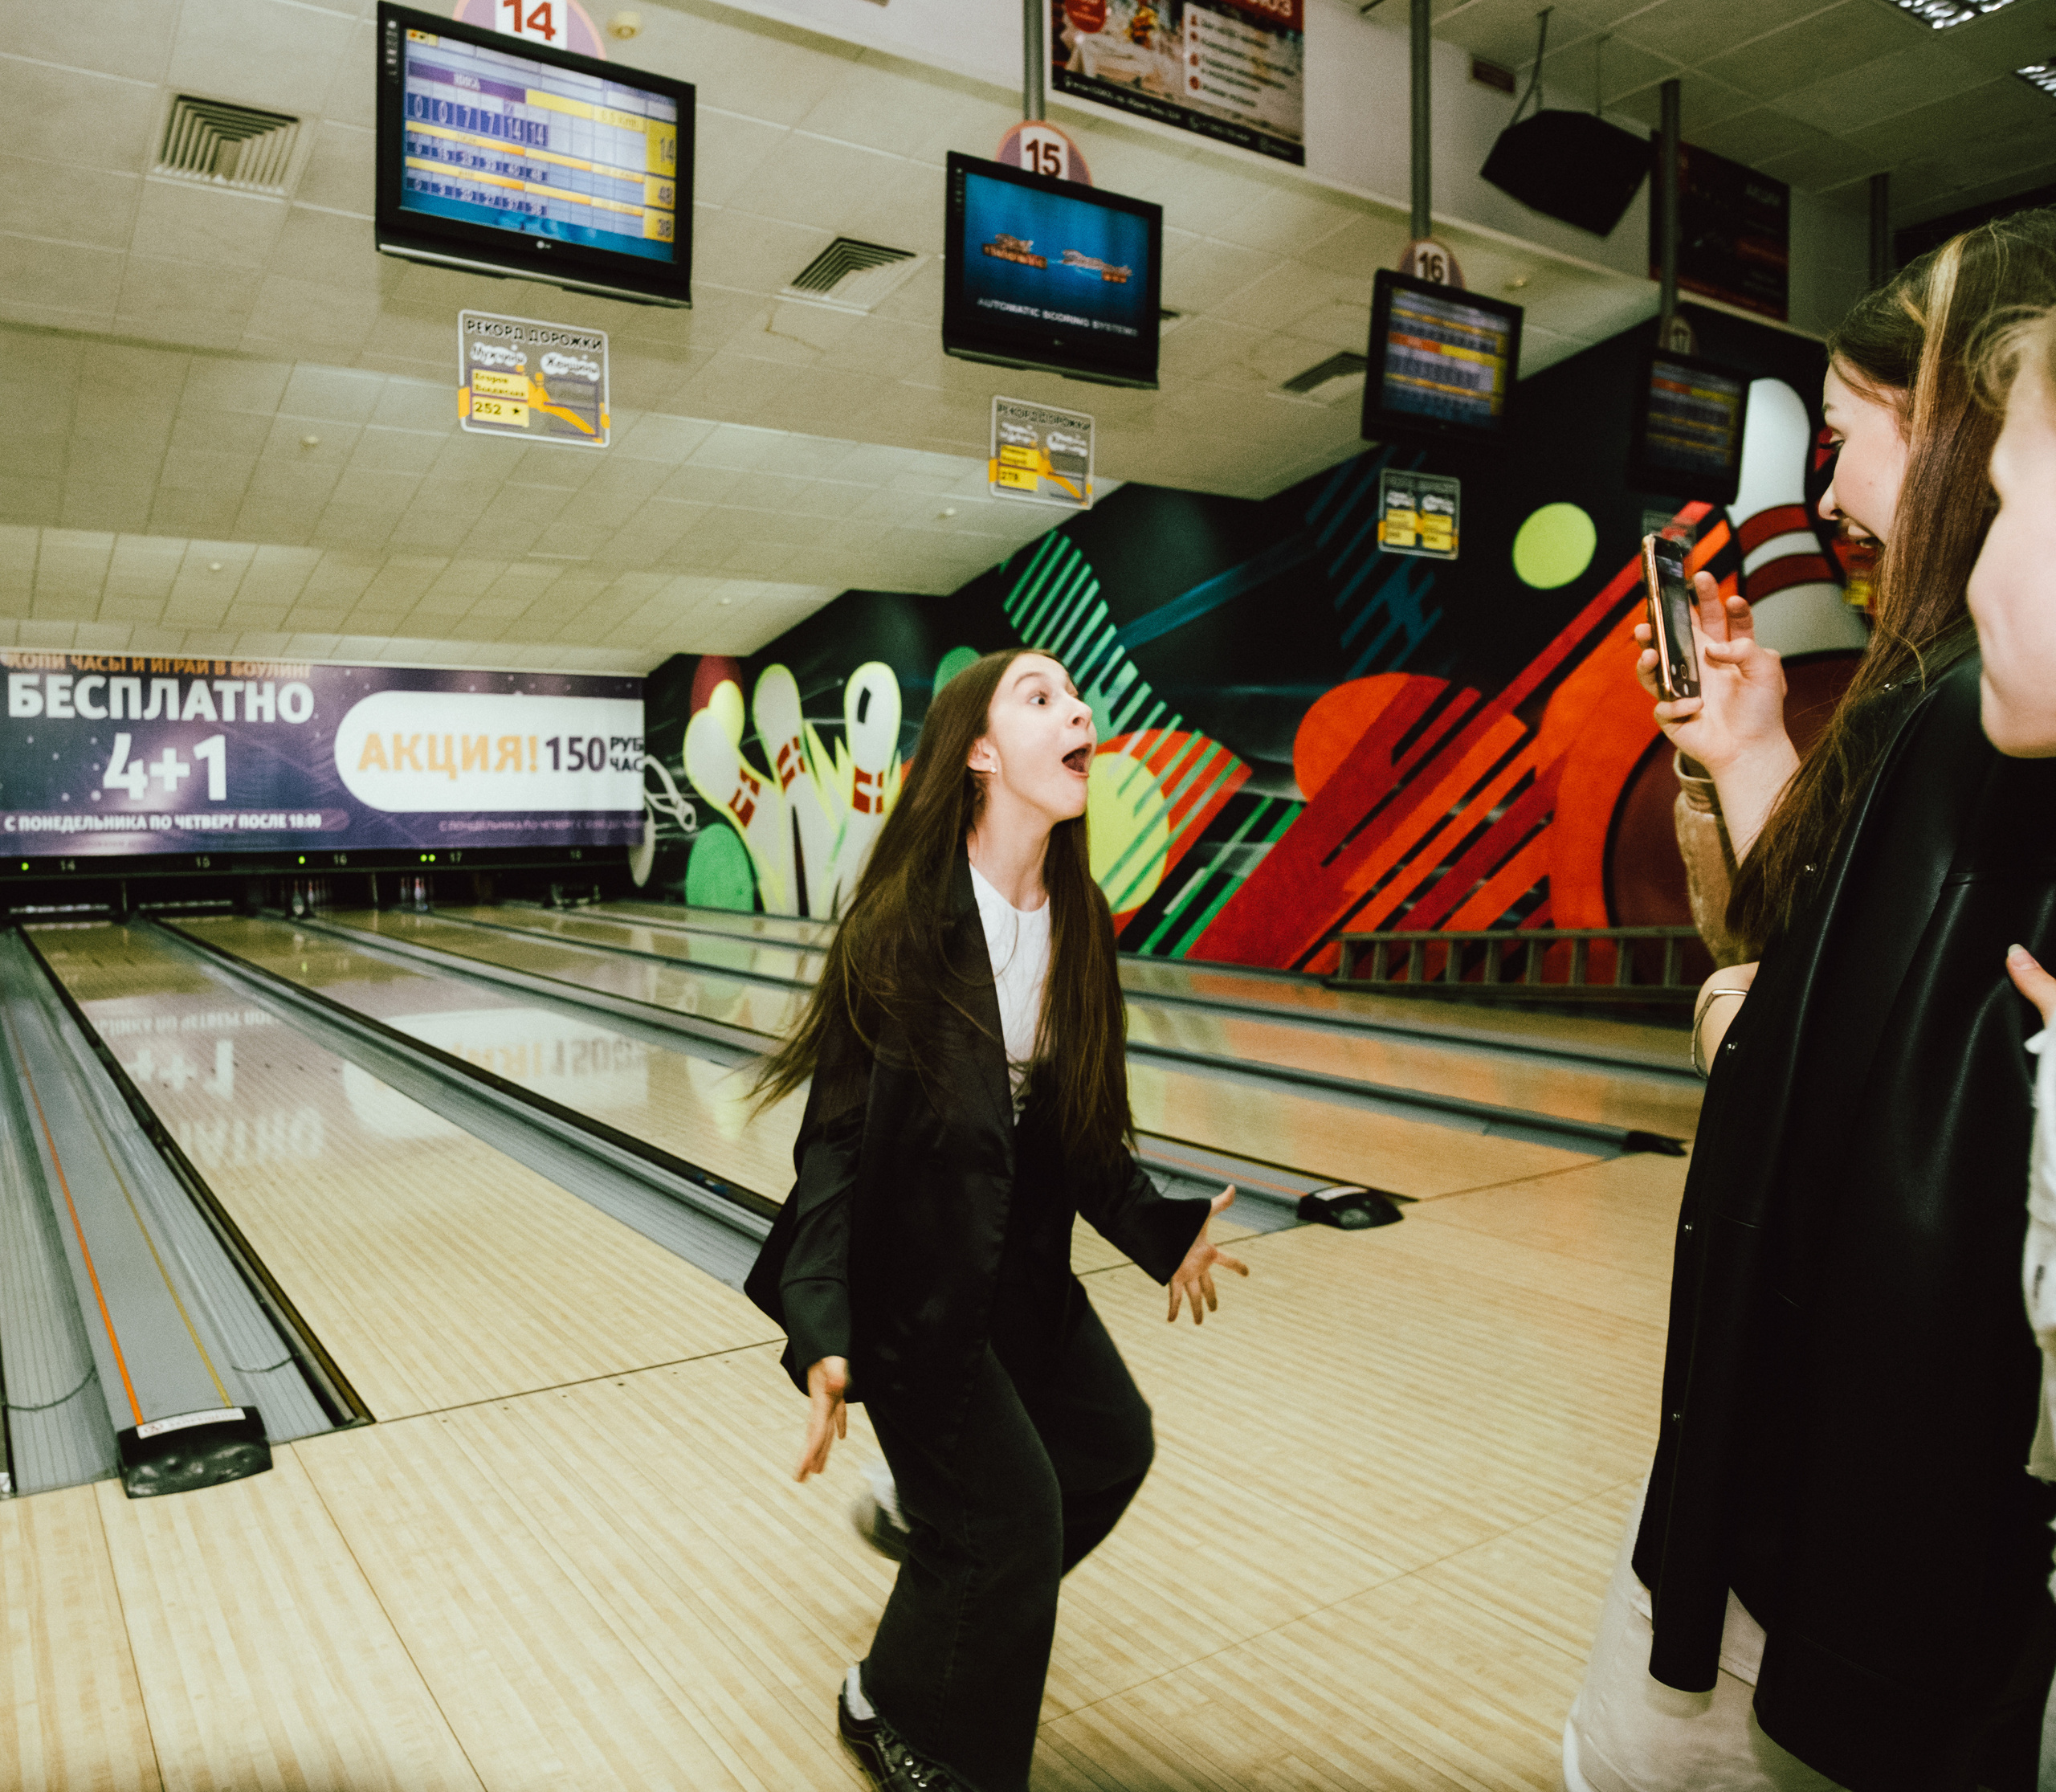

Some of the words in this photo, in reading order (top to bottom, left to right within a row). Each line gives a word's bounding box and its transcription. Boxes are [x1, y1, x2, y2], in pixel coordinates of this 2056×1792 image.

[503, 0, 557, 42] 14
[414, 95, 424, 119] 0
[438, 100, 448, 124] 0
[463, 105, 472, 129] 7
[486, 112, 496, 134] 7
[506, 116, 522, 141] 14
[529, 122, 545, 145] 14
[1025, 138, 1062, 178] 15
[1418, 251, 1445, 282] 16
[977, 297, 1041, 318] AUTOMATIC
[467, 319, 524, 341] РЕКОРД
[528, 328, 602, 350] ДОРОЖКИ
[475, 402, 502, 415] 252
[8, 654, 66, 670] КОПИ
[71, 655, 127, 672] ЧАСЫ
[132, 657, 145, 672] И
[214, 661, 226, 676] В
[8, 673, 315, 724] БЕСПЛАТНО
[103, 733, 226, 801] 4+1
[357, 733, 538, 781] АКЦИЯ!
[545, 735, 606, 773] 150
[4, 815, 16, 832] С
[18, 814, 148, 834] ПОНЕДЕЛЬНИКА
[149, 814, 173, 831] ПО
[174, 814, 237, 831] ЧЕТВЕРГ
[238, 813, 288, 830] ПОСЛЕ
[60, 859, 76, 872] 14
